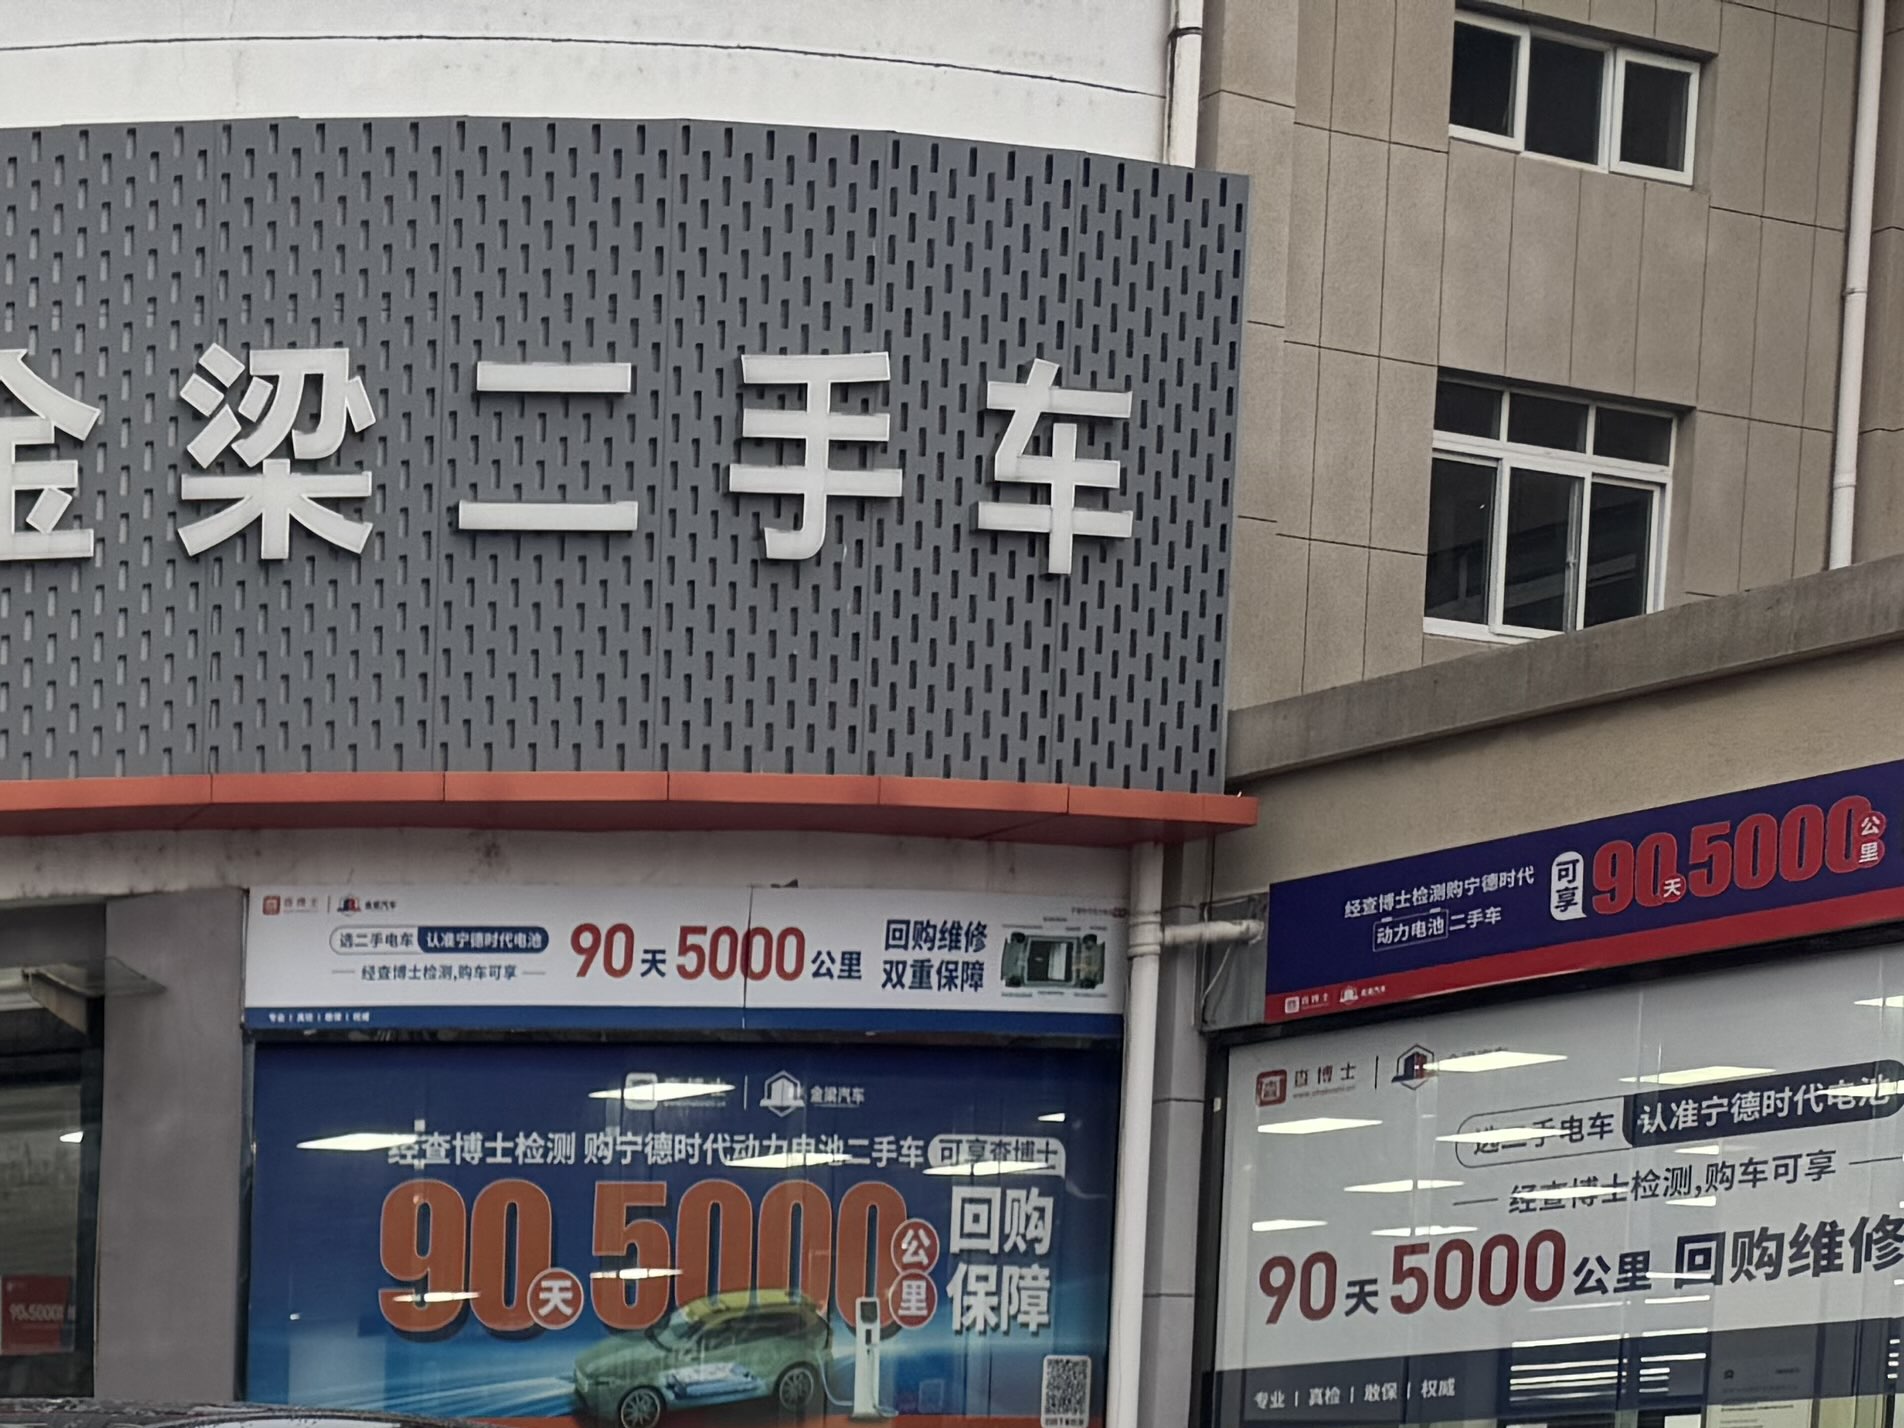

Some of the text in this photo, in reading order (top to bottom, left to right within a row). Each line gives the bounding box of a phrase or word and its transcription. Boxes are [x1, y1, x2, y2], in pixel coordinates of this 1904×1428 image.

[1344, 865, 1535, 919] 经查博士检测购宁德时代
[1554, 858, 1581, 913] 可享
[339, 931, 414, 949] 选二手电车
[883, 918, 989, 954] 回购维修
[881, 958, 985, 993] 双重保障
[949, 1186, 1055, 1257] 回购
[946, 1261, 1052, 1336] 保障
[1253, 1390, 1286, 1410] 专业
